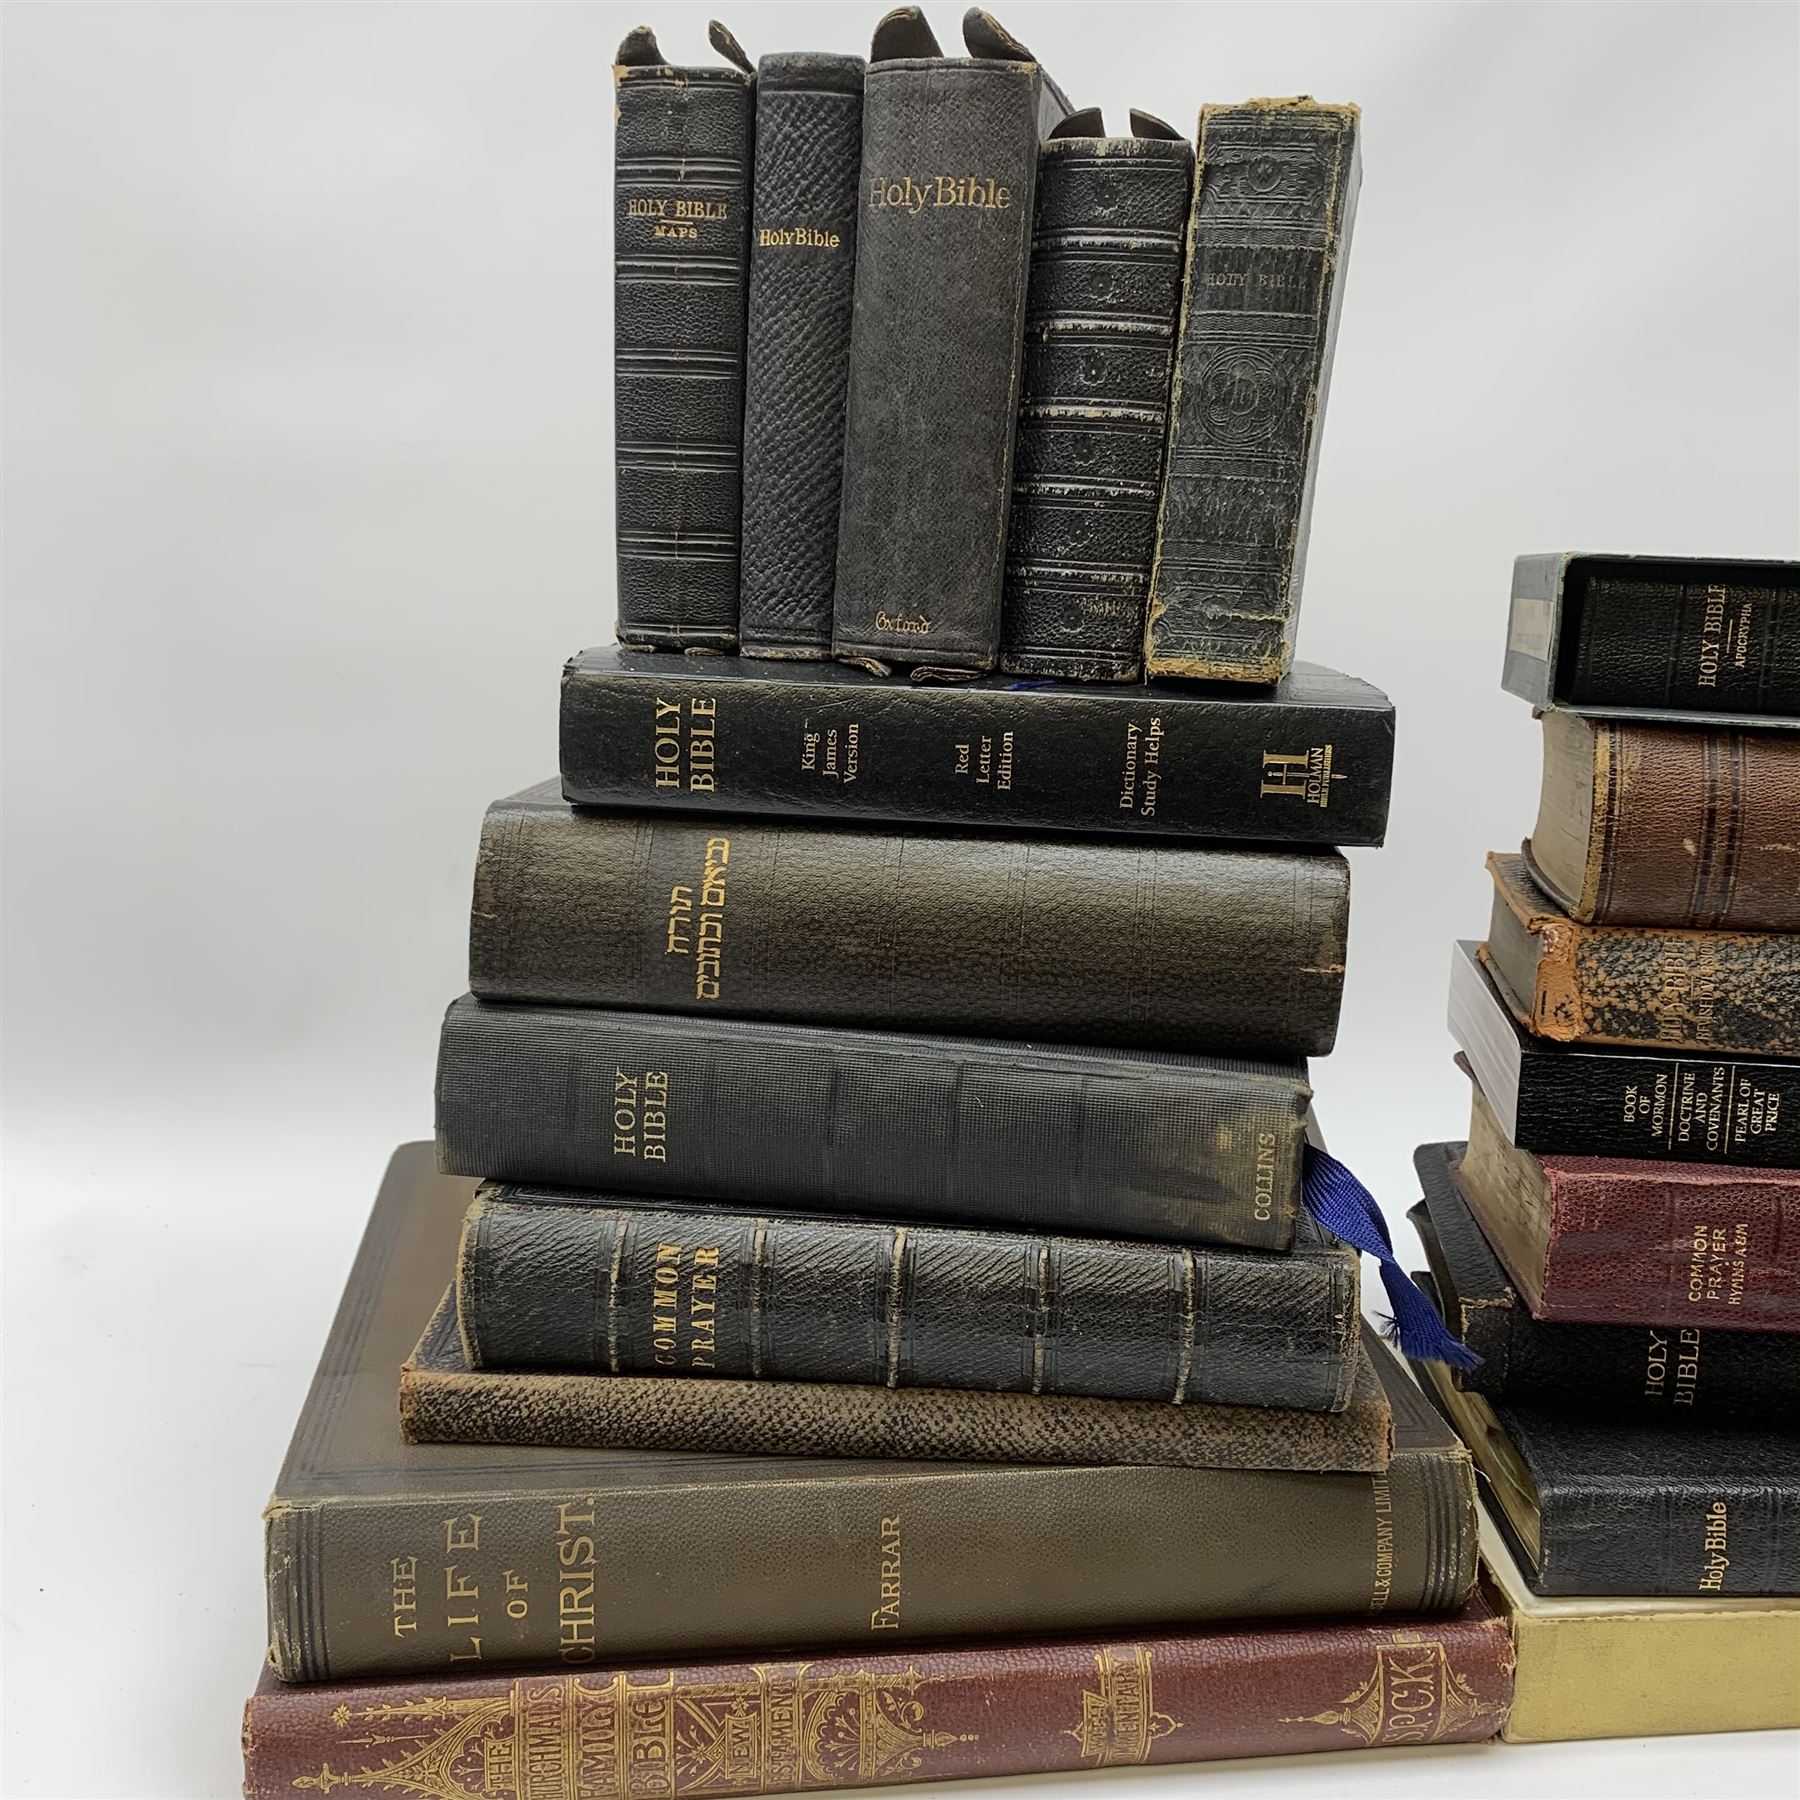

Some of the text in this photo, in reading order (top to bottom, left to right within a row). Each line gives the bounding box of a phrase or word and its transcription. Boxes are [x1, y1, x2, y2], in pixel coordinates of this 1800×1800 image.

[627, 199, 728, 220] HOLY BIBLE
[869, 176, 1011, 214] Holy Bible
[654, 224, 698, 239] MAPS
[759, 228, 841, 248] Holy Bible
[1698, 583, 1727, 687] HOLY BIBLE
[1734, 602, 1753, 668] APOCRYPHA
[655, 697, 682, 789] HOLY
[690, 696, 717, 792] BIBLE
[801, 732, 821, 770] King
[822, 728, 840, 779] James
[843, 722, 859, 784] Version
[954, 743, 970, 775] Red
[975, 735, 992, 784] Letter
[996, 730, 1014, 791] Edition
[1119, 721, 1143, 809] Dictionary
[1141, 717, 1165, 817] Study Helps
[1306, 747, 1324, 805] HOLMAN
[1658, 937, 1687, 1042] HOLY BIBLE
[613, 1066, 638, 1157] HOLY
[644, 1071, 669, 1163] BIBLE
[1623, 1085, 1638, 1122] BOOK
[1638, 1095, 1651, 1114] OF
[1651, 1073, 1669, 1137] MORMON
[1678, 1072, 1696, 1142] DOCTRINE
[1694, 1092, 1708, 1123] AND
[1706, 1066, 1726, 1151] COVENANTS
[1734, 1078, 1752, 1142] PEARL OF
[1750, 1088, 1766, 1134] GREAT
[1764, 1092, 1780, 1132] PRICE
[1254, 1132, 1276, 1222] COLLINS
[1688, 1224, 1708, 1302] COMMON
[1706, 1227, 1727, 1300] PRAYER
[1728, 1223, 1749, 1305] HYMNS A&M
[653, 1242, 683, 1366] COMMON
[691, 1246, 720, 1369] PRAYER
[1644, 1329, 1668, 1396] HOLY
[1673, 1328, 1700, 1406] BIBLE
[556, 1496, 598, 1664] CHRIST.
[871, 1514, 901, 1630] FARRAR
[1699, 1501, 1730, 1591] Holy Bible
[391, 1555, 418, 1638] THE
[443, 1512, 483, 1662] LIFE
[502, 1569, 529, 1619] OF
[488, 1743, 513, 1789] THE
[577, 1696, 617, 1800] FAMILY
[629, 1696, 672, 1796] BIBLE
[732, 1719, 751, 1776] NEW
